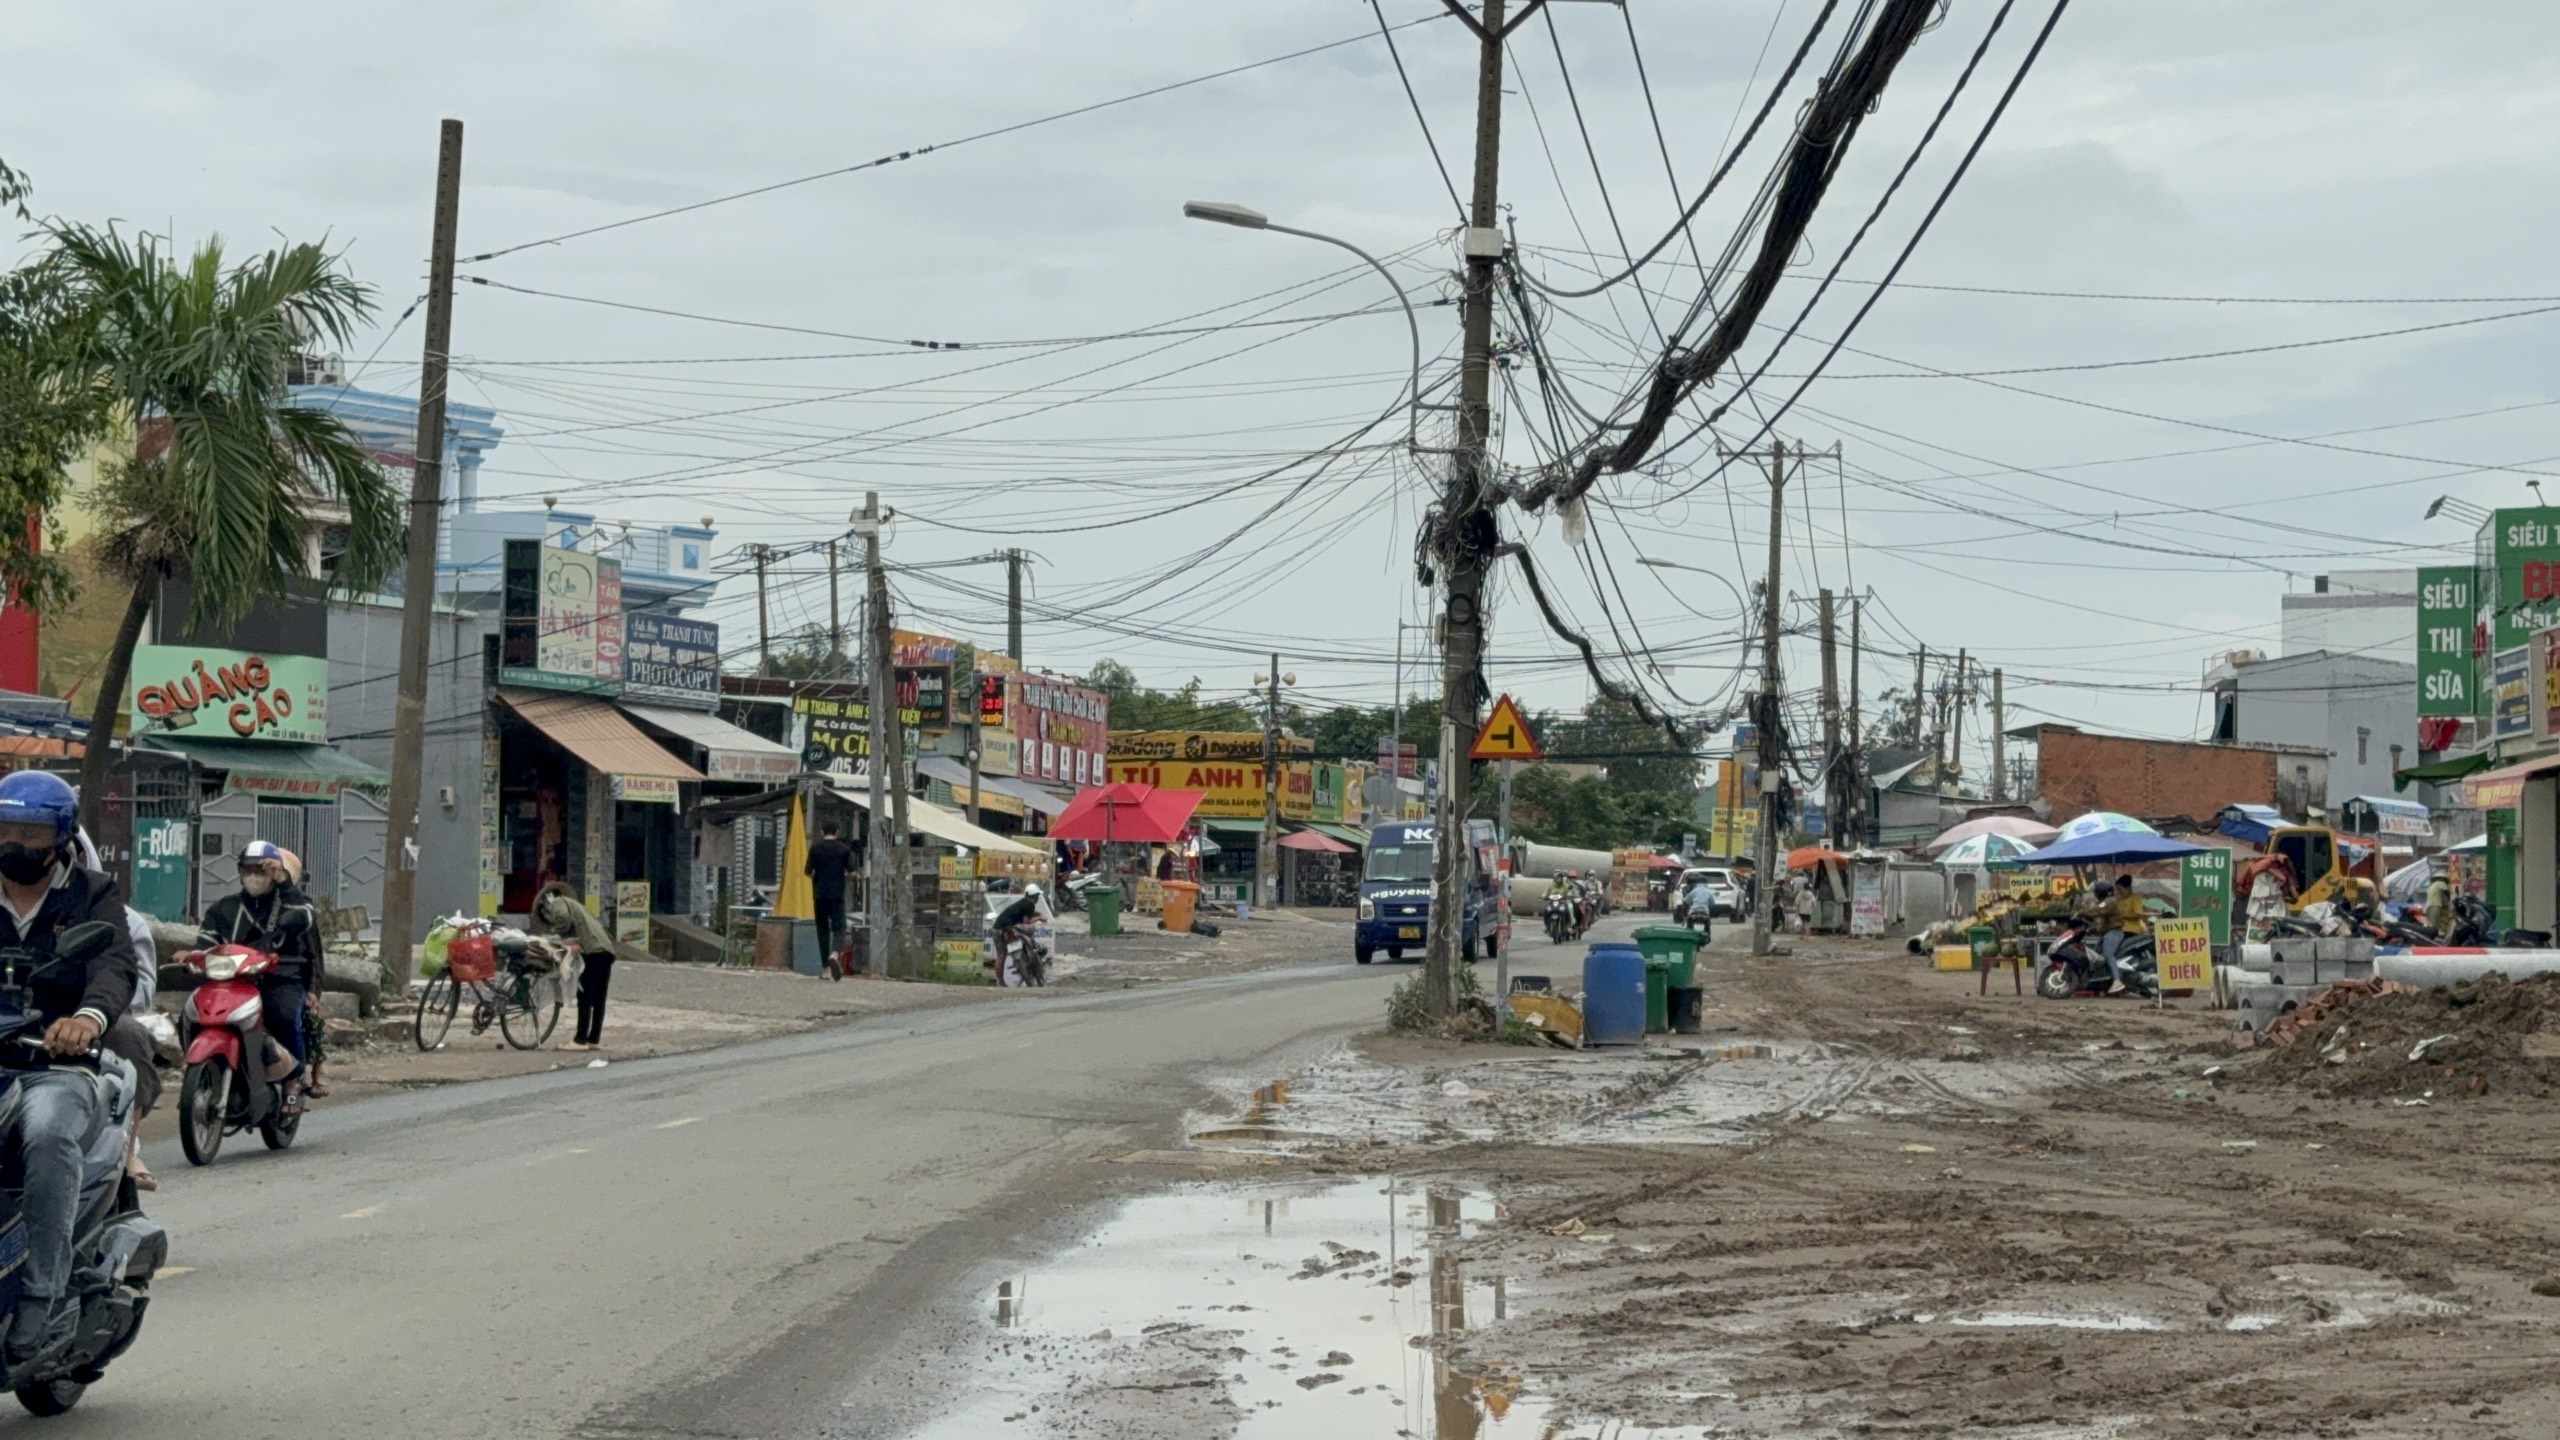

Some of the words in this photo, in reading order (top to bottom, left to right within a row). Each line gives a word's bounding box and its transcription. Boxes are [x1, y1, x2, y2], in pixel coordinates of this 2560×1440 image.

[2508, 520, 2547, 547] SIÊU
[2423, 577, 2467, 610] SIÊU
[2428, 627, 2462, 658] THỊ
[137, 655, 271, 719] QUẢNG
[631, 660, 714, 690] PHOTOCOPY
[2425, 669, 2464, 700] SỮA
[229, 688, 293, 738] CÁO
[812, 731, 839, 752] Mr
[843, 734, 869, 755] Ch
[1185, 767, 1243, 789] ANH
[2189, 852, 2225, 870] SIÊU
[2193, 874, 2219, 891] THỊ
[2159, 938, 2177, 954] XE
[2180, 937, 2207, 957] ĐẠP
[2168, 961, 2201, 983] ĐIỆN
